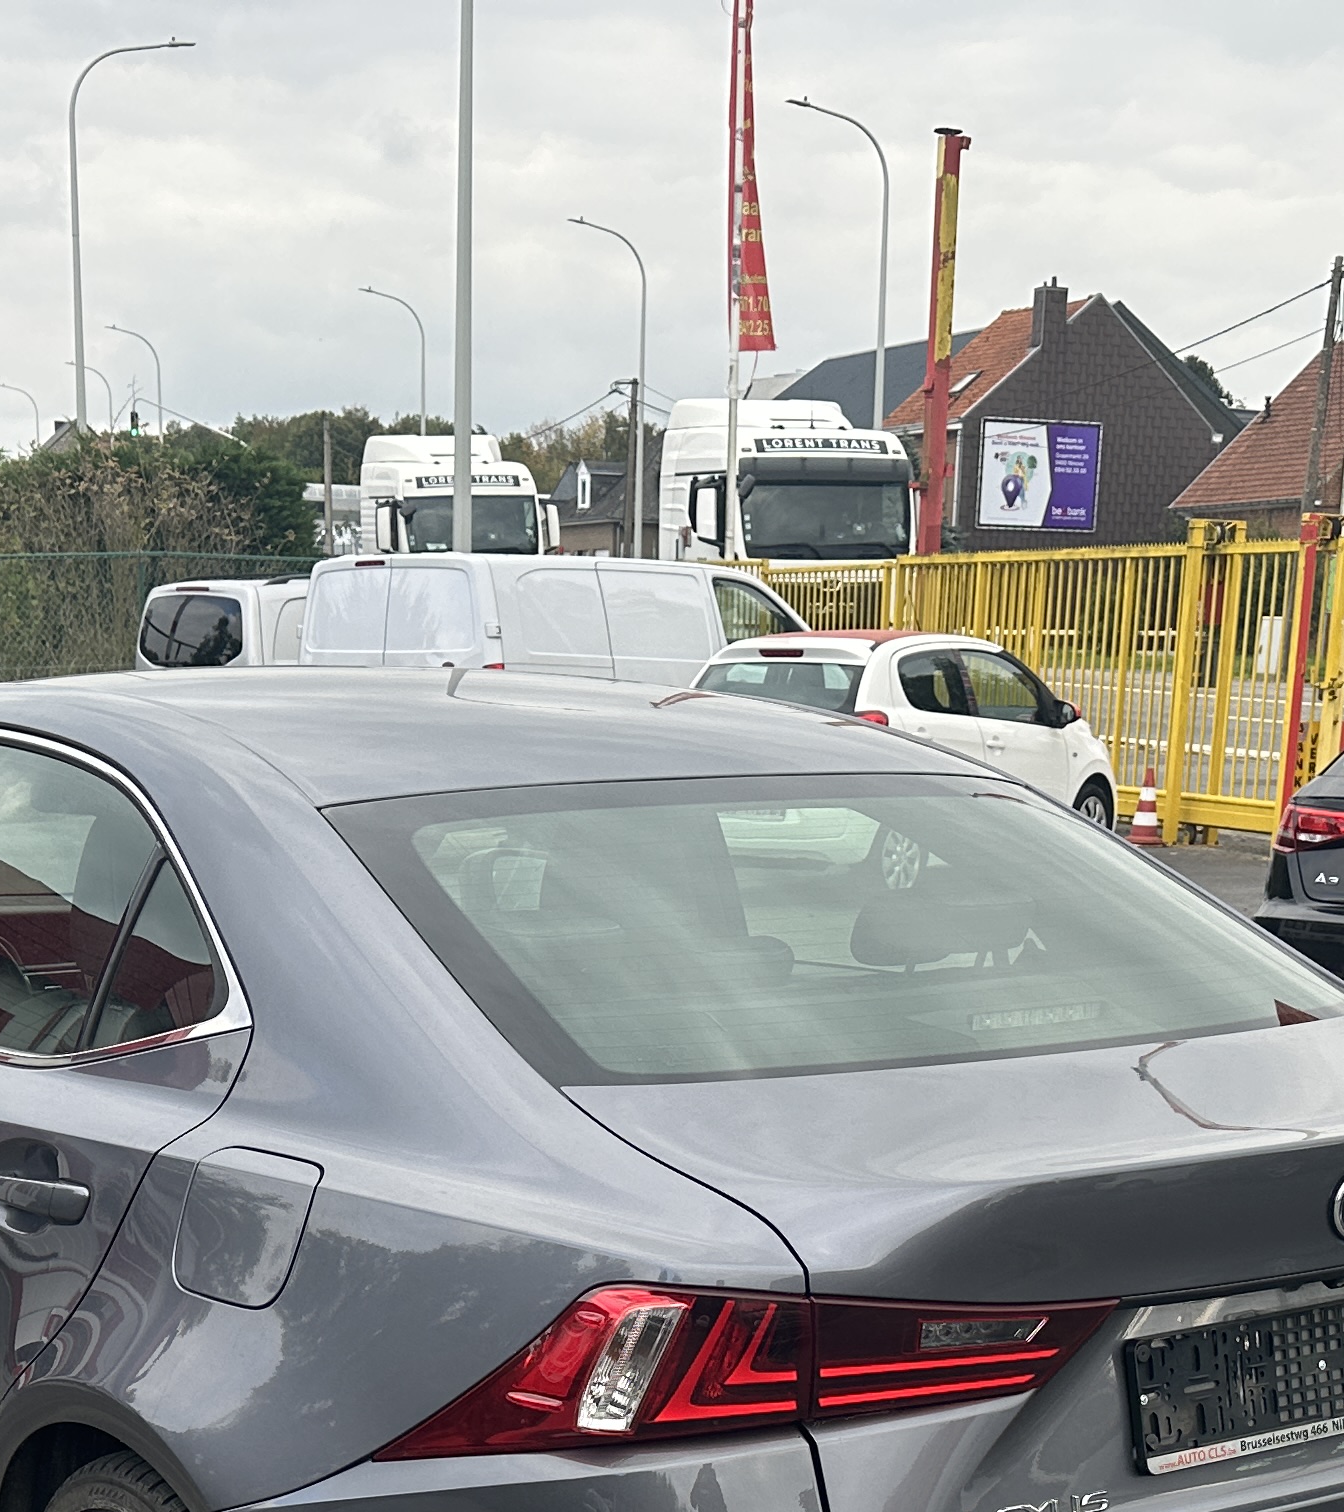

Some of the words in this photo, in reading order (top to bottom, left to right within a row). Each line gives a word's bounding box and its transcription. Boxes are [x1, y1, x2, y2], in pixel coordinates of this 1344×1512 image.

[762, 438, 824, 449] LORENT
[829, 439, 881, 450] TRANS
[422, 476, 454, 485] LORE
[474, 475, 515, 484] TRANS
[1240, 1427, 1309, 1452] Brusselsestwg
[1310, 1422, 1329, 1437] 466
